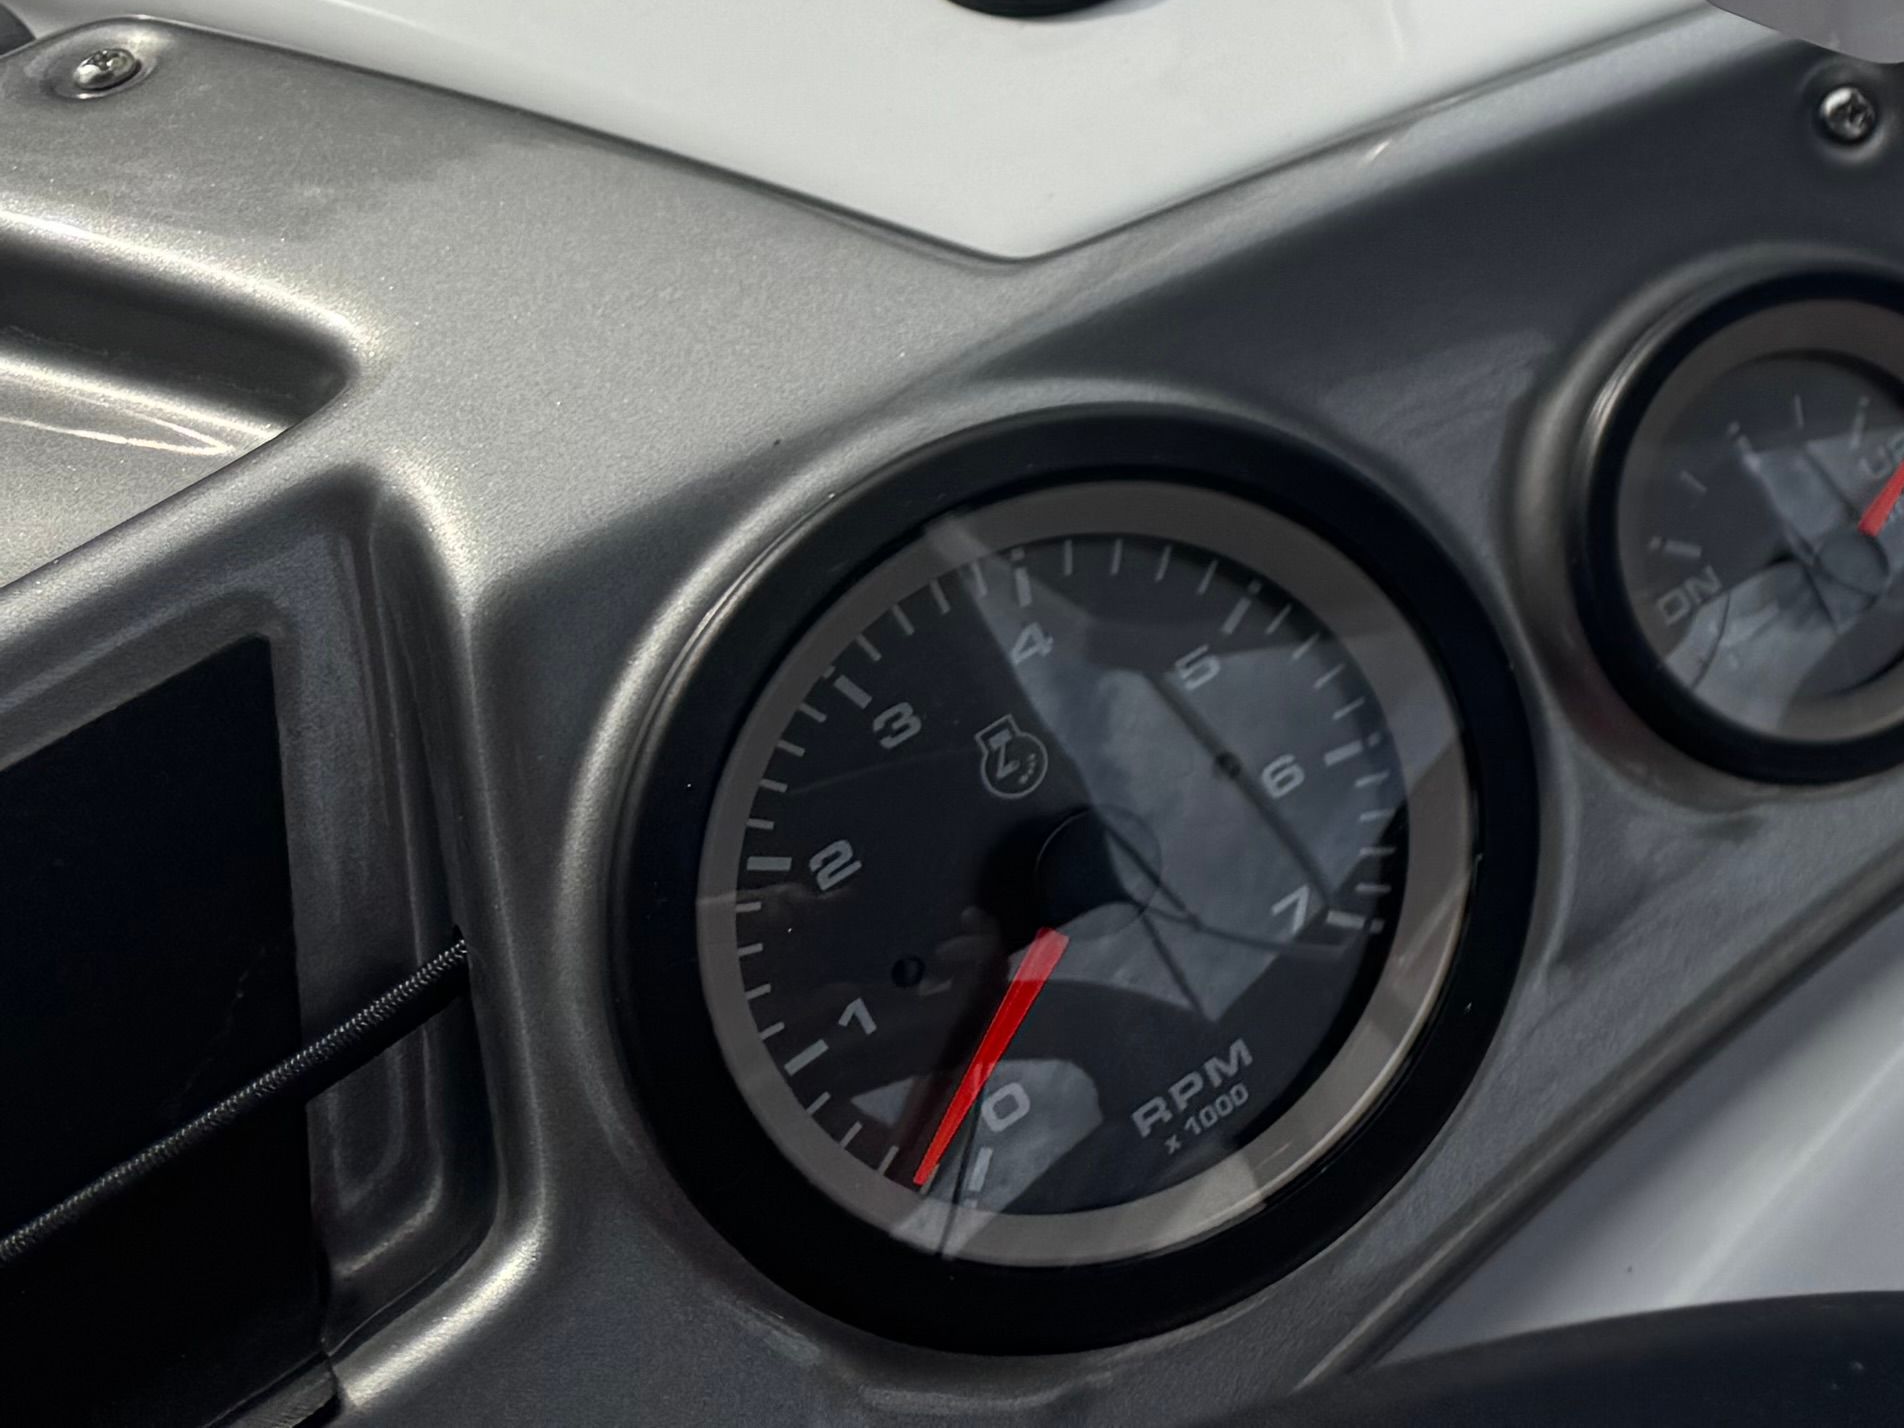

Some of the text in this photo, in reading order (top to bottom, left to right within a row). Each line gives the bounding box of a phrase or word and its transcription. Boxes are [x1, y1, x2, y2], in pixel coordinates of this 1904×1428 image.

[1012, 624, 1053, 665] 4
[1174, 647, 1221, 690] 5
[872, 702, 923, 747] 3
[1262, 754, 1305, 796] 6
[809, 840, 862, 892] 2
[1271, 885, 1310, 932] 7
[838, 999, 878, 1035] 1
[981, 1083, 1031, 1132] 0
[1131, 1038, 1252, 1139] RPM
[1184, 1085, 1250, 1138] 1000
